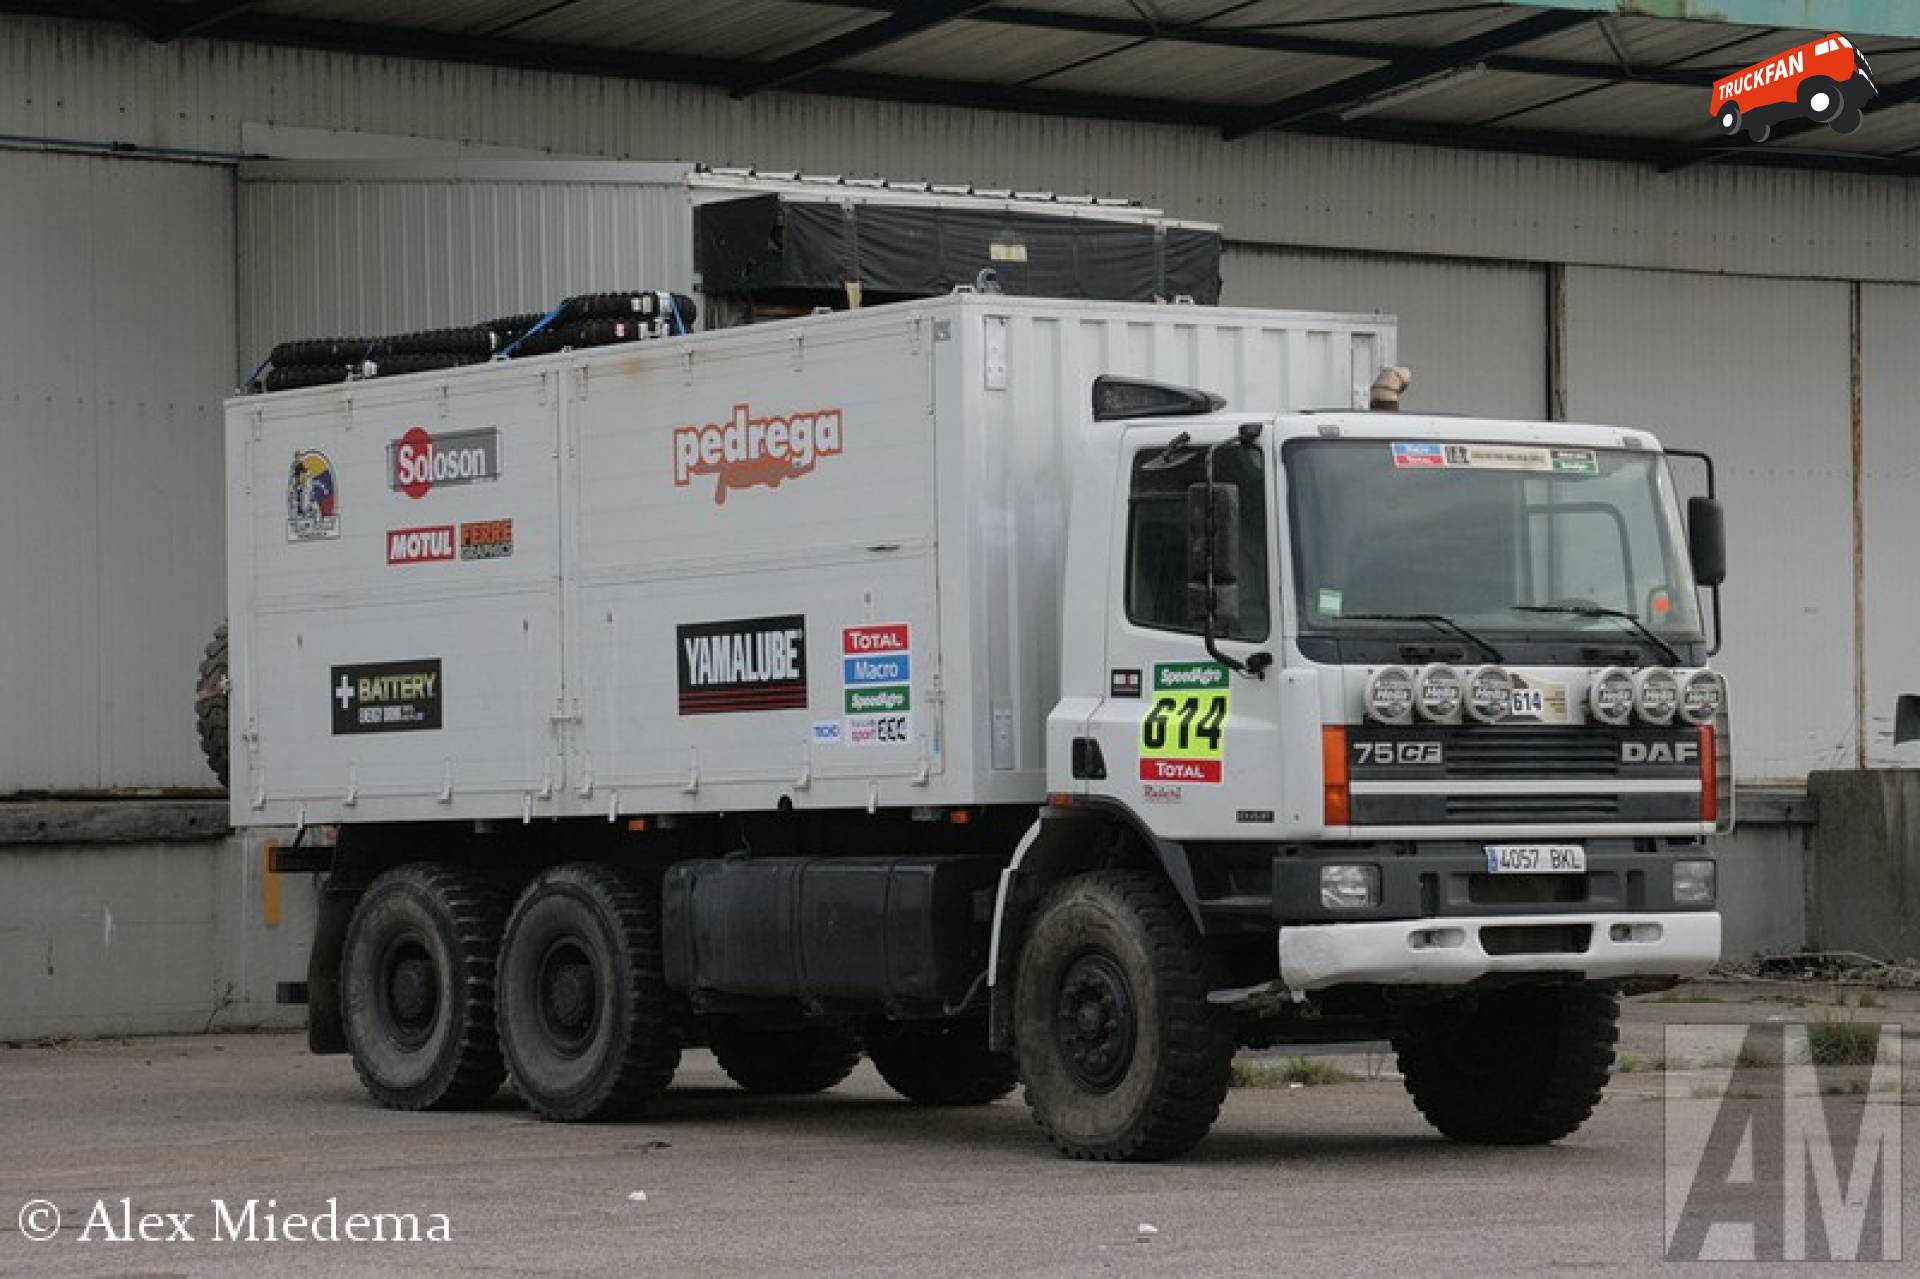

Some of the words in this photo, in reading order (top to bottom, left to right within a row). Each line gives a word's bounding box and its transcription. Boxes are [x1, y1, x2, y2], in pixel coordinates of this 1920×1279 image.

[674, 403, 843, 487] pedrega
[398, 444, 487, 485] Soloson
[391, 531, 452, 560] MOTUL
[685, 630, 802, 684] YAMALUBE
[358, 671, 438, 702] BATTERY
[1514, 692, 1542, 711] 614
[1144, 697, 1227, 750] 614
[1621, 743, 1698, 762] DAF
[1156, 762, 1205, 779] TOTAL
[1500, 848, 1539, 870] 4057
[1550, 848, 1582, 870] BKL
